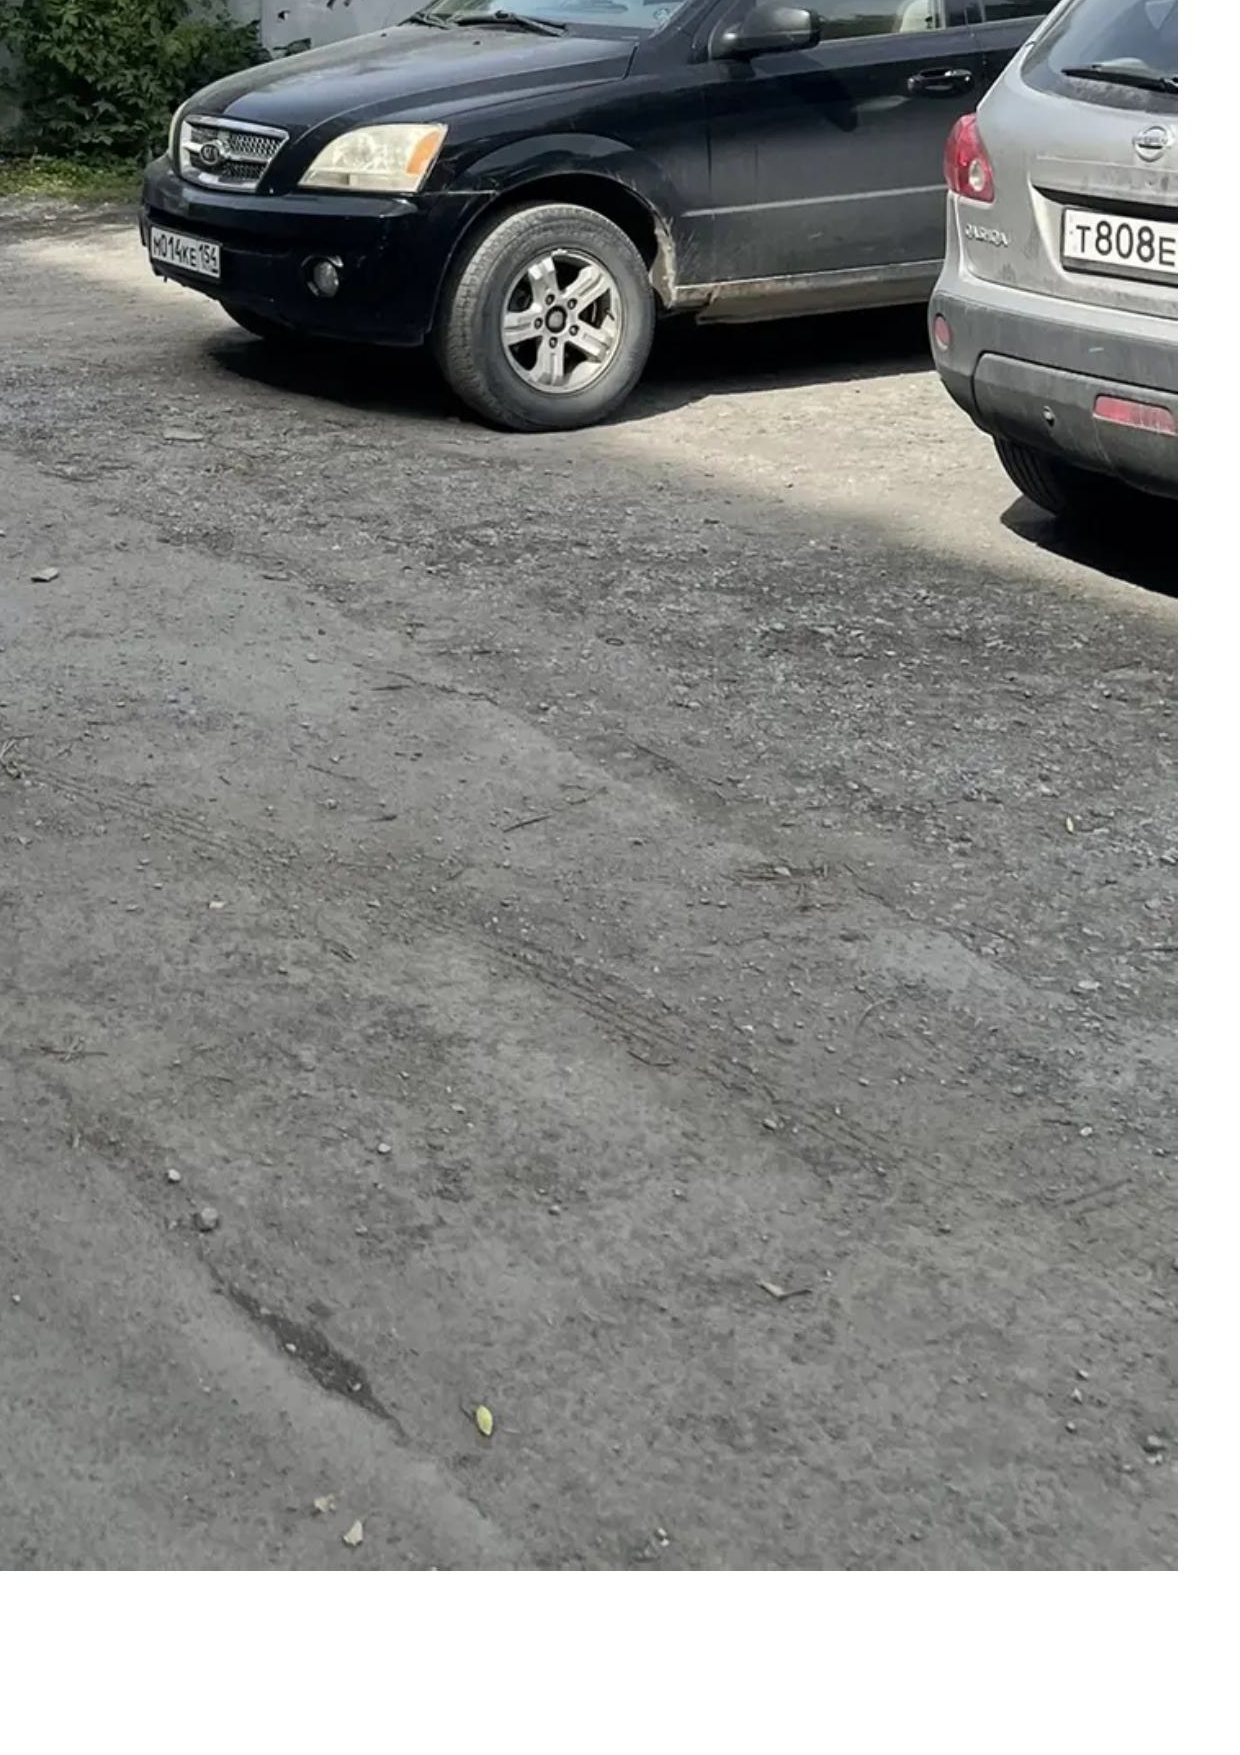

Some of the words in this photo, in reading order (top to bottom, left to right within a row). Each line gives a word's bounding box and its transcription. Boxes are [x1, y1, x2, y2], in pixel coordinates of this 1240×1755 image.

[153, 234, 196, 267] М014КЕ
[199, 244, 217, 266] 154
[1075, 220, 1176, 267] Т808Е
